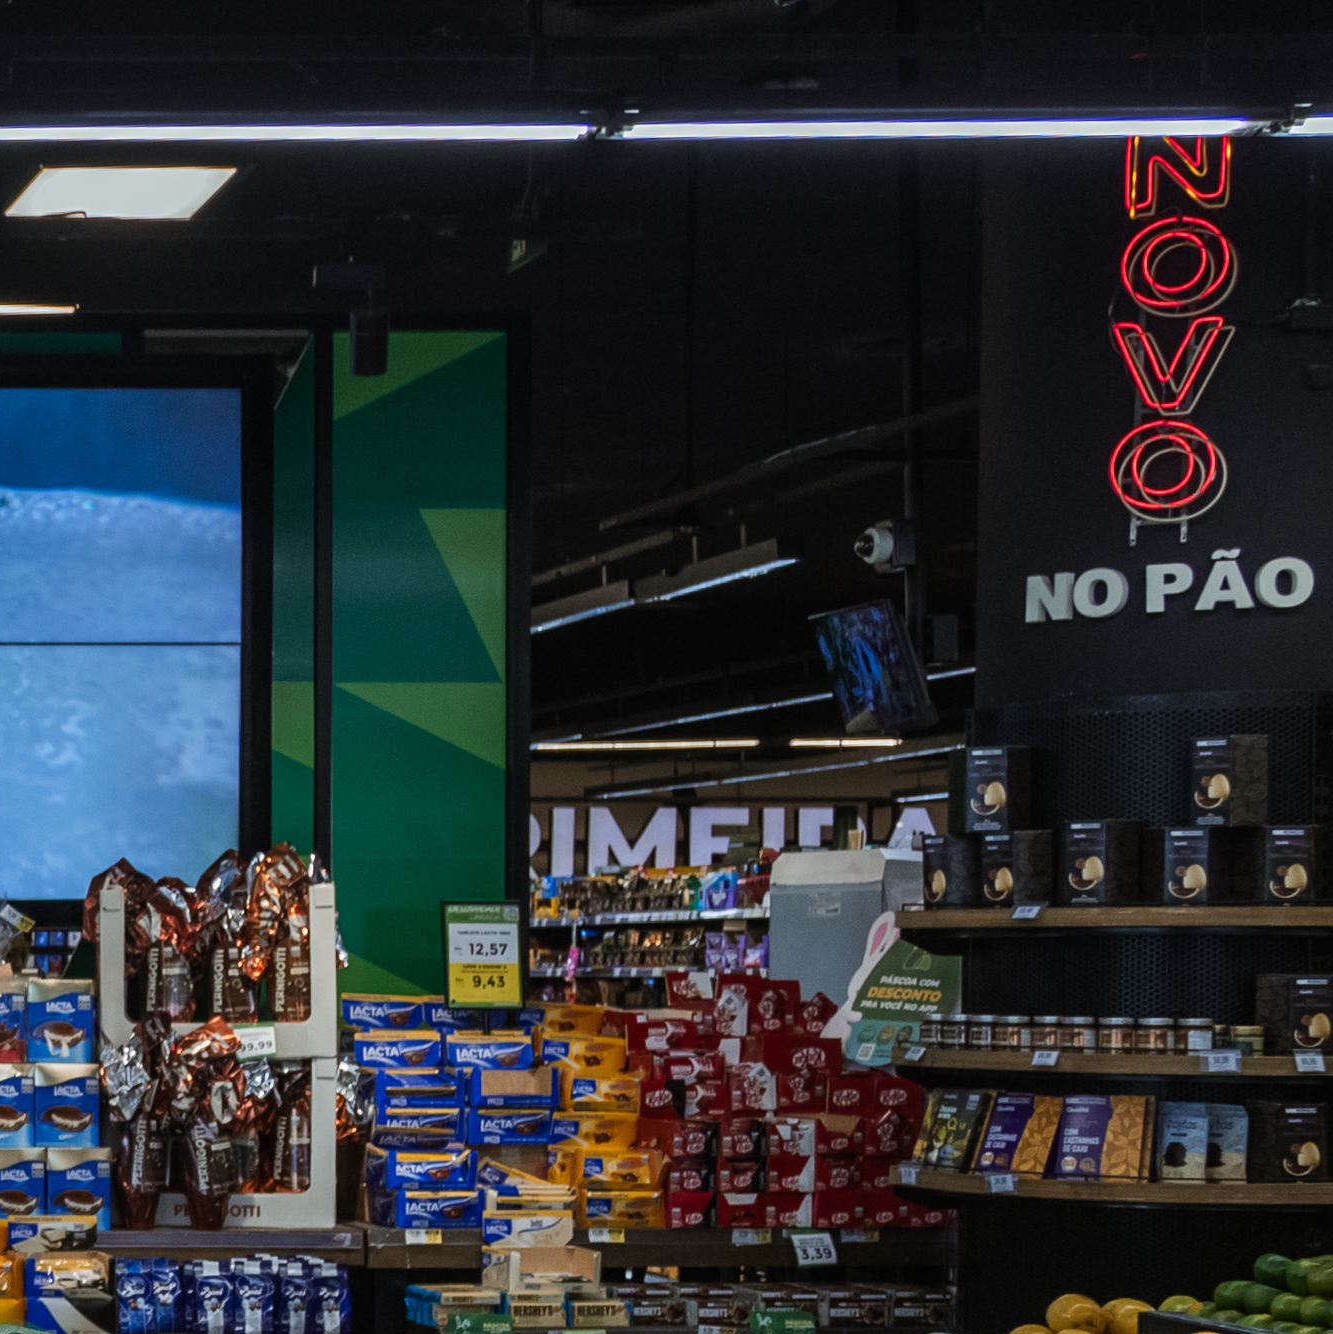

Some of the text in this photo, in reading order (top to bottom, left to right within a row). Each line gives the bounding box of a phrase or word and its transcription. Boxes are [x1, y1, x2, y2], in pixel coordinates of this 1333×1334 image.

[1025, 549, 1315, 622] NO PÃO
[469, 943, 508, 956] 12,57
[146, 947, 159, 1012] PERNIGOTTI
[213, 948, 224, 1013] PERNIGOTTI
[275, 947, 286, 1012] PERNIGOTTI
[472, 976, 505, 989] 9,43
[880, 974, 917, 985] PÁSCOA
[867, 986, 942, 1002] DESCONTO
[46, 1001, 76, 1014] LACTA
[350, 1006, 384, 1018] LACTA
[860, 1000, 938, 1014] PRA VOCÊ NO APP
[363, 1046, 399, 1059] LACTA
[456, 1047, 492, 1060] LACTA
[544, 1044, 566, 1055] LACTA
[54, 1085, 83, 1097] LACTA
[480, 1119, 513, 1132] LACTA
[1064, 1128, 1078, 1136] COM
[1063, 1136, 1099, 1145] CASTANHAS
[132, 1119, 147, 1186] PERNIGOTTI
[274, 1115, 287, 1182] PERNIGOTTI
[194, 1124, 210, 1191] PERNIGOTTI
[0, 1169, 30, 1181] LACTA
[66, 1169, 95, 1181] LACTA
[396, 1164, 425, 1174] ACTA
[405, 1202, 439, 1215] LACTA
[487, 1224, 508, 1234] LACTA
[801, 1248, 833, 1261] 3,39
[513, 1306, 553, 1317] HERSHEY'S
[577, 1306, 617, 1317] HERSHEY'S
